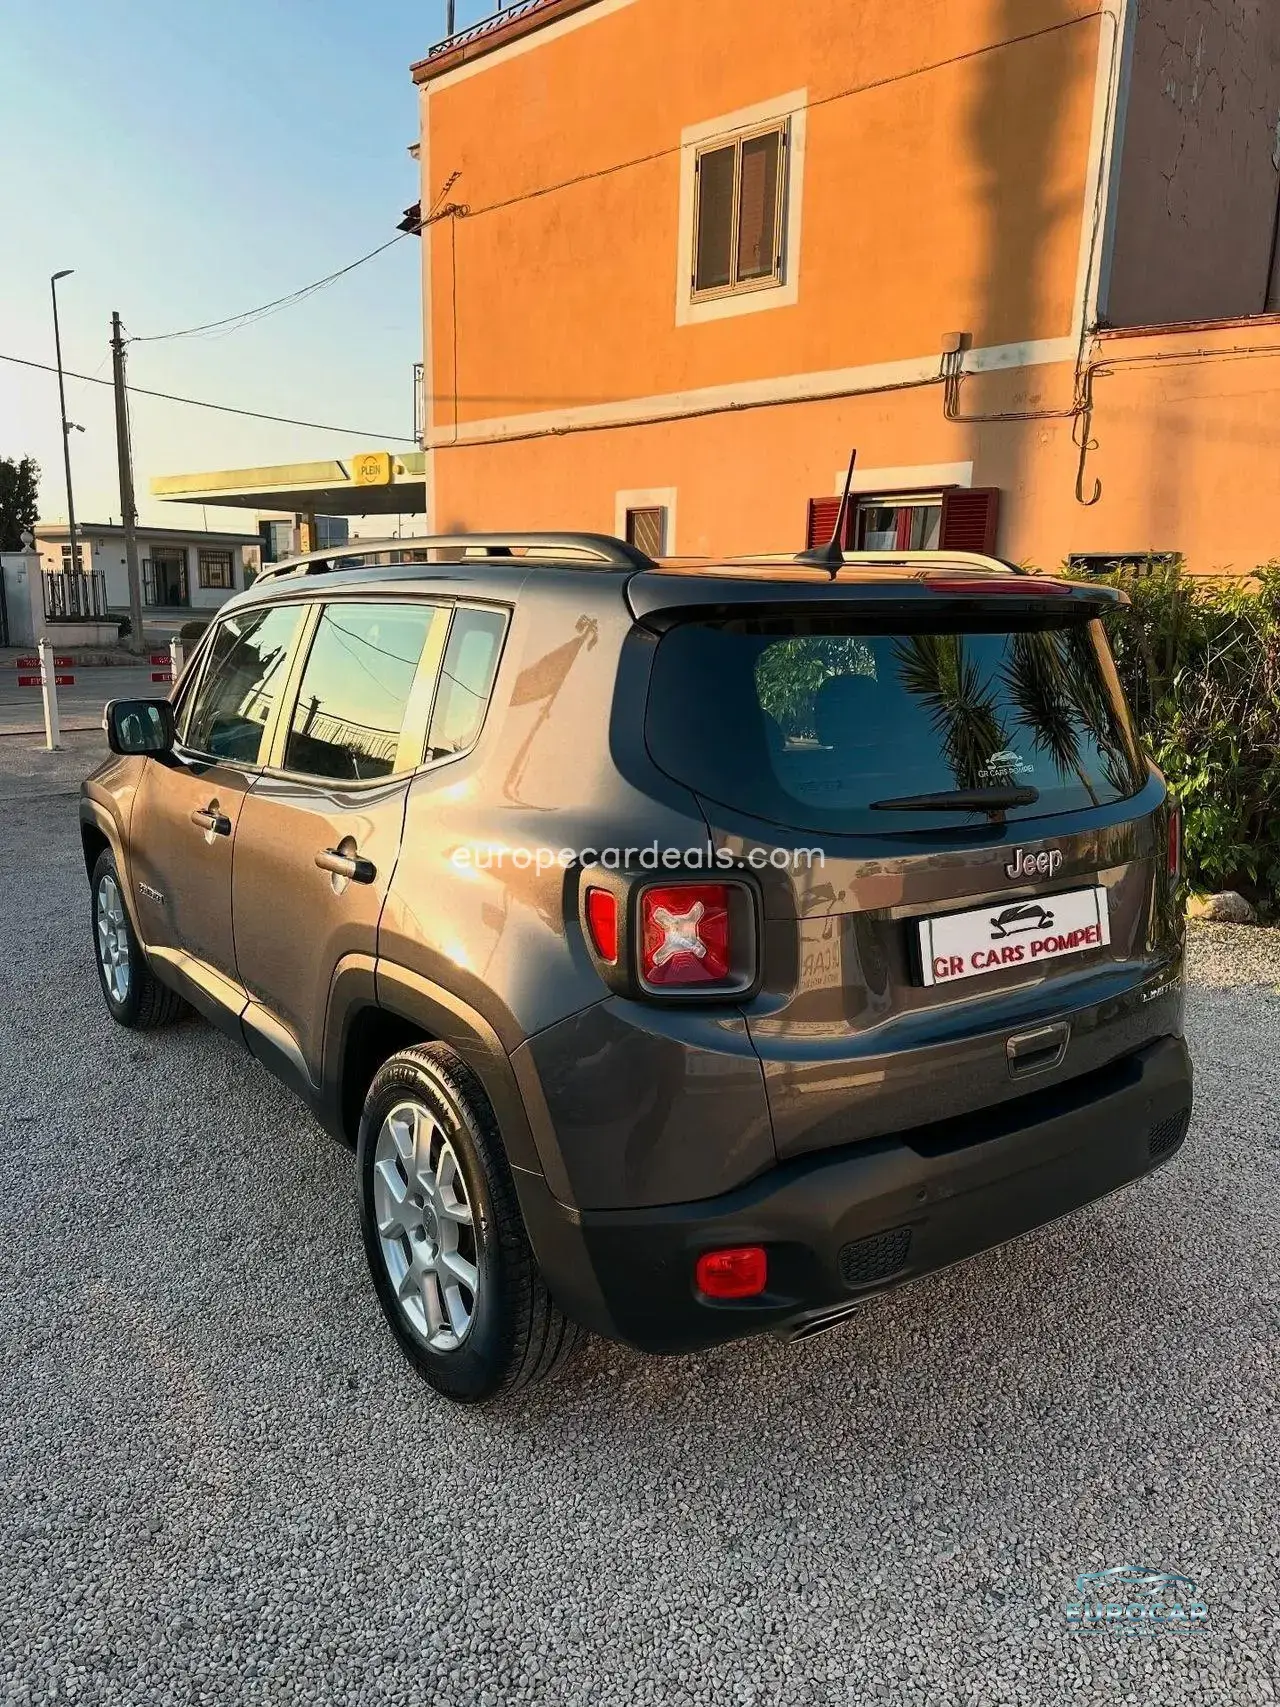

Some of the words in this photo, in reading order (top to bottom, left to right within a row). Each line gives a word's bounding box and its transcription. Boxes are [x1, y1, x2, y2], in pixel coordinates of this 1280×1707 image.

[361, 465, 381, 476] PLEIN
[978, 769, 989, 778] GR
[990, 767, 1008, 777] CARS
[1006, 848, 1063, 879] Jeep
[933, 955, 964, 978] GR
[971, 945, 1025, 970] CARS
[1031, 922, 1102, 958] POMPEI
